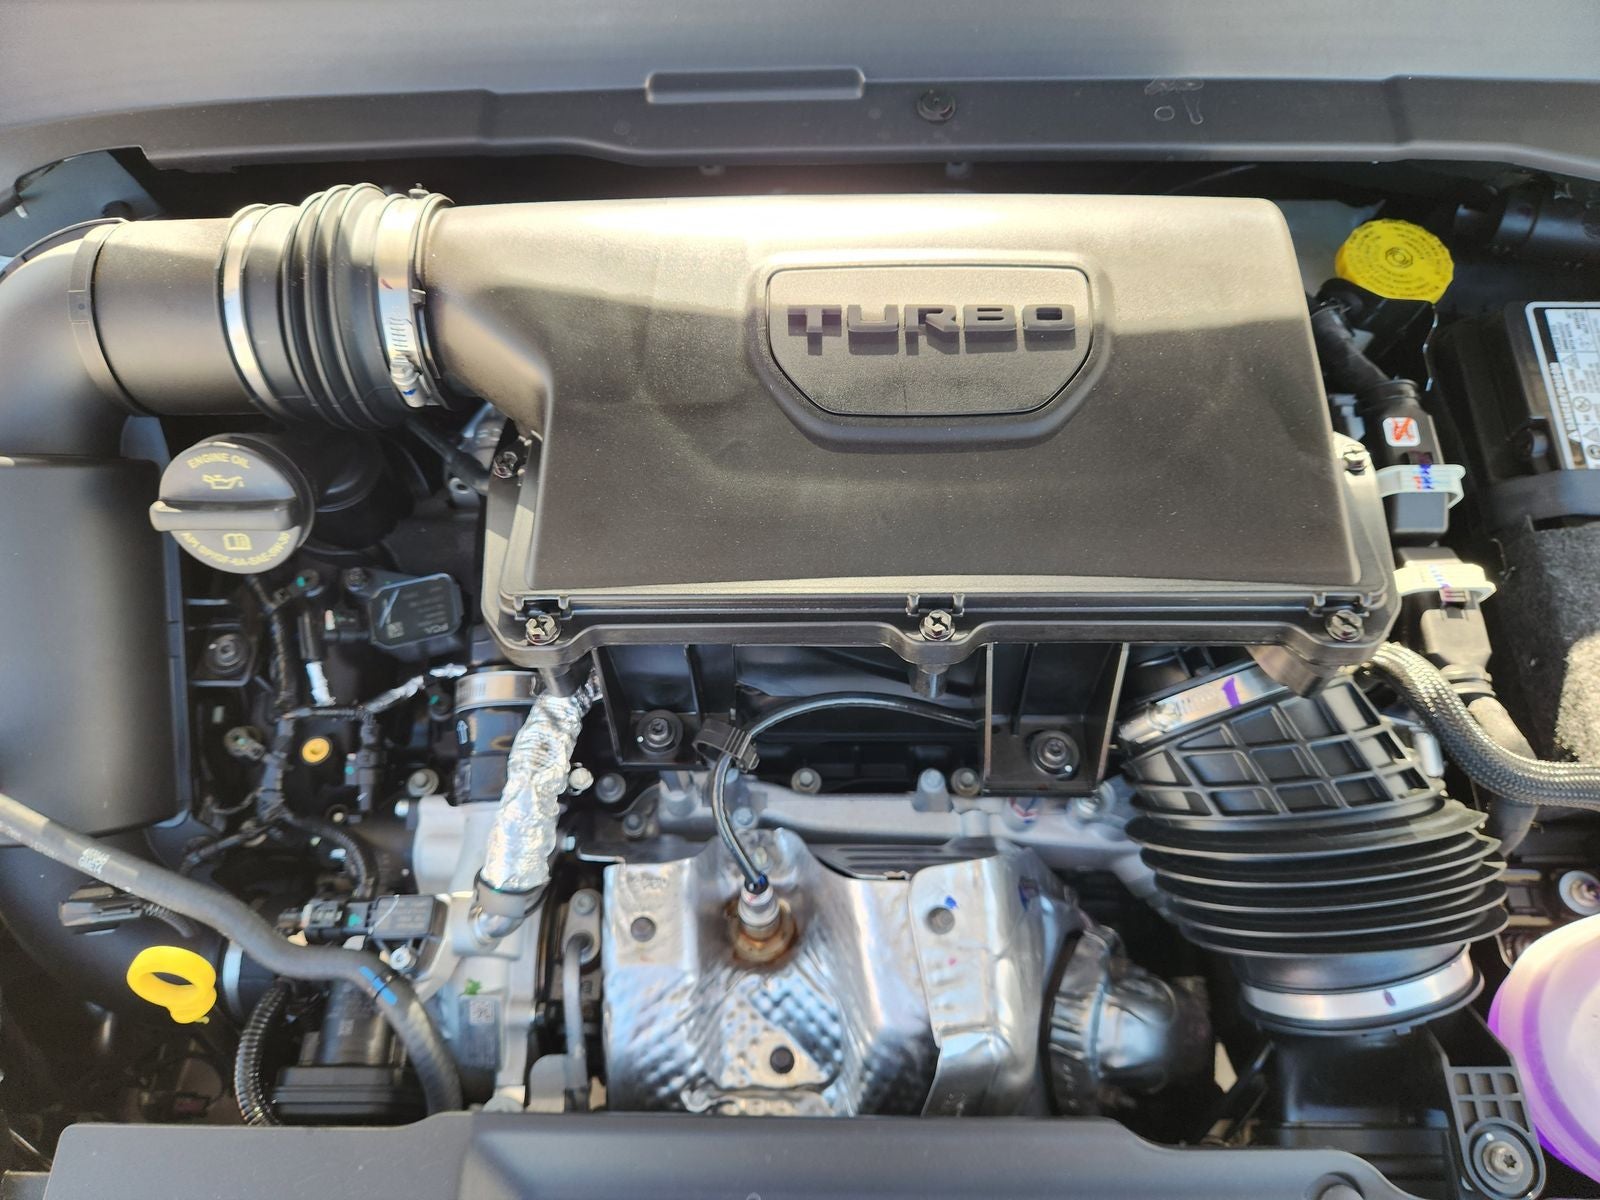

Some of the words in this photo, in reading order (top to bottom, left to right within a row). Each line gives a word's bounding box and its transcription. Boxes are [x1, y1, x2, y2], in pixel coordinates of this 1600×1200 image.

[787, 304, 1076, 343] TURBO
[187, 453, 230, 469] ENGINE
[231, 455, 250, 469] OIL
[181, 532, 200, 548] API
